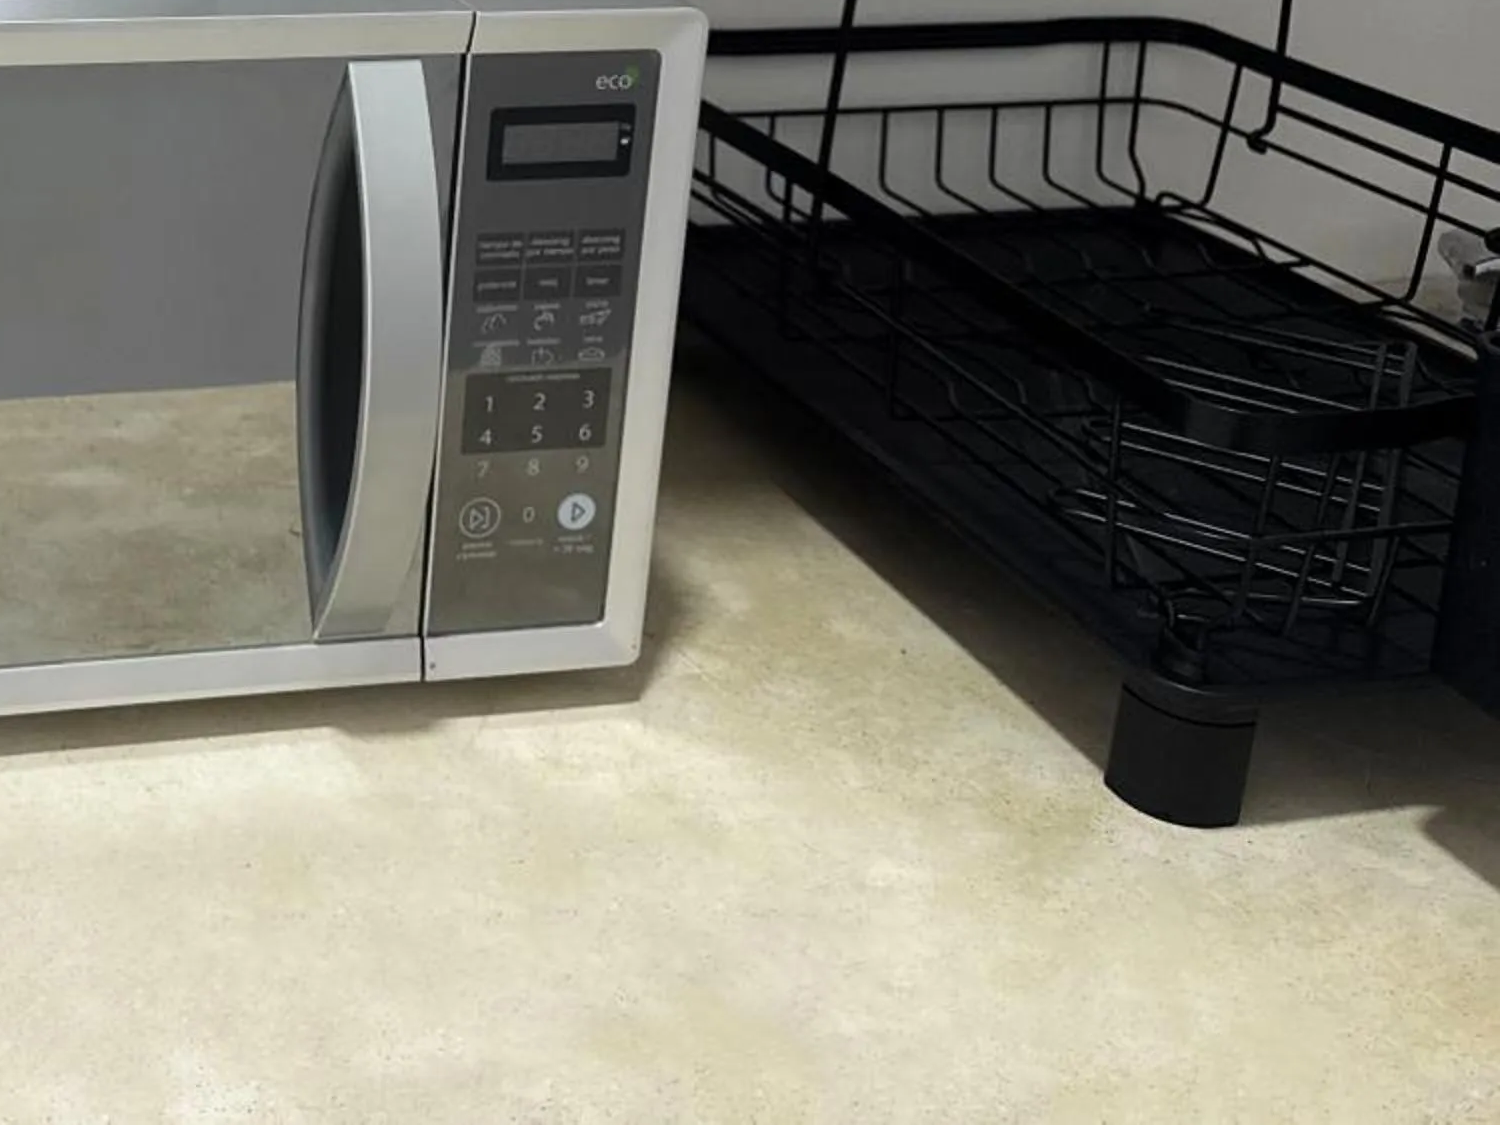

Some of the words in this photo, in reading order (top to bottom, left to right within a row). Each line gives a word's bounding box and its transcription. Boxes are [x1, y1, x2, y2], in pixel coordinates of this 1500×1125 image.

[595, 74, 633, 90] eco
[485, 395, 493, 412] 1
[533, 393, 546, 411] 2
[583, 390, 596, 409] 3
[479, 429, 492, 446] 4
[531, 426, 543, 443] 5
[579, 424, 591, 441] 6
[477, 460, 489, 478] 7
[528, 458, 540, 475] 8
[576, 455, 589, 473] 9
[523, 507, 535, 523] 0
